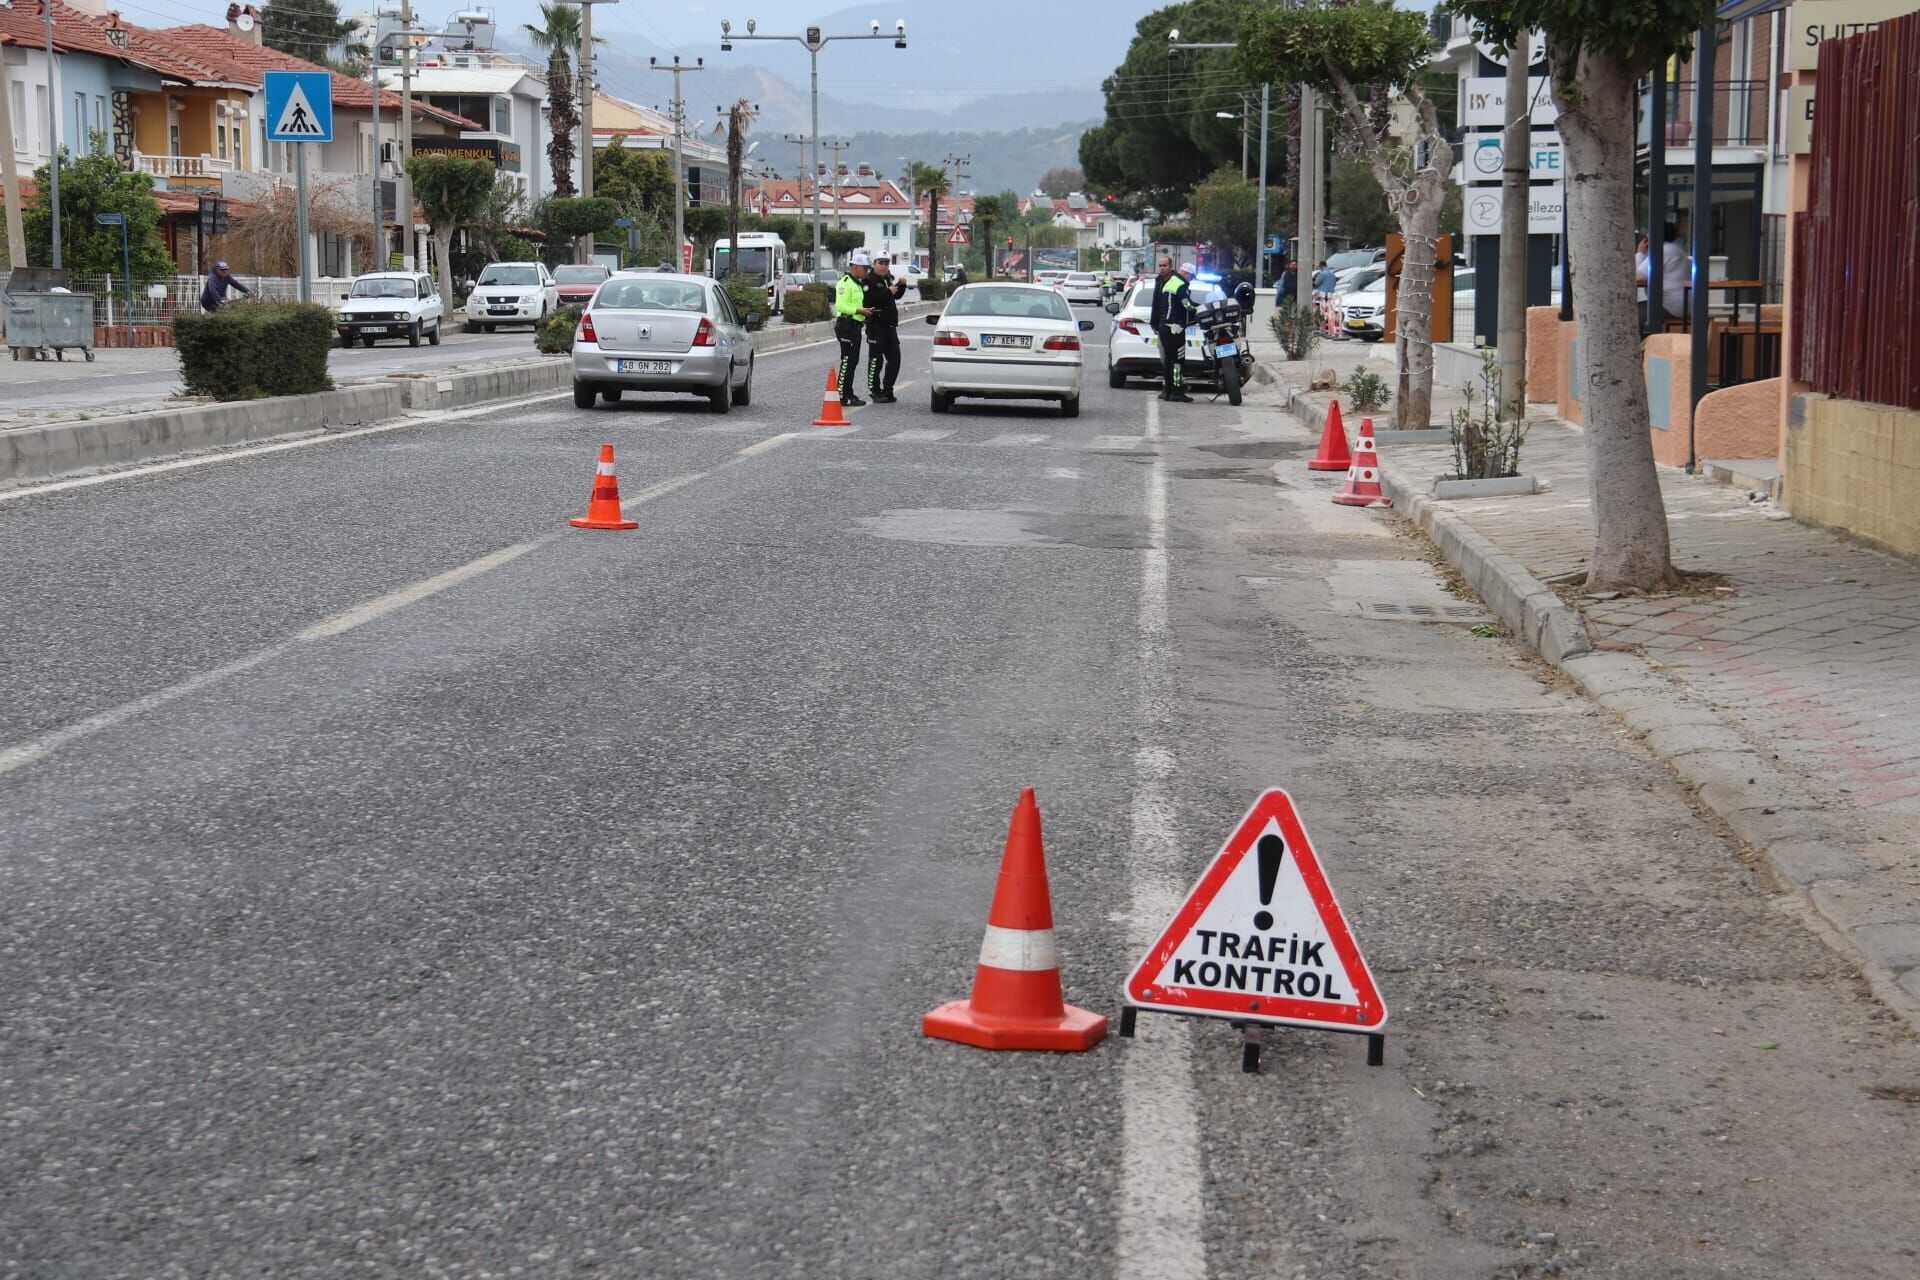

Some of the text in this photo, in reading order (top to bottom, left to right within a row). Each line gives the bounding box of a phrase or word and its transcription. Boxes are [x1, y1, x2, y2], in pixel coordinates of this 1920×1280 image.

[987, 336, 996, 344] 07
[1020, 338, 1030, 346] 92
[623, 361, 634, 370] 48
[638, 362, 649, 370] GN
[1196, 930, 1325, 967] TRAFİK
[1173, 958, 1342, 1000] KONTROL
